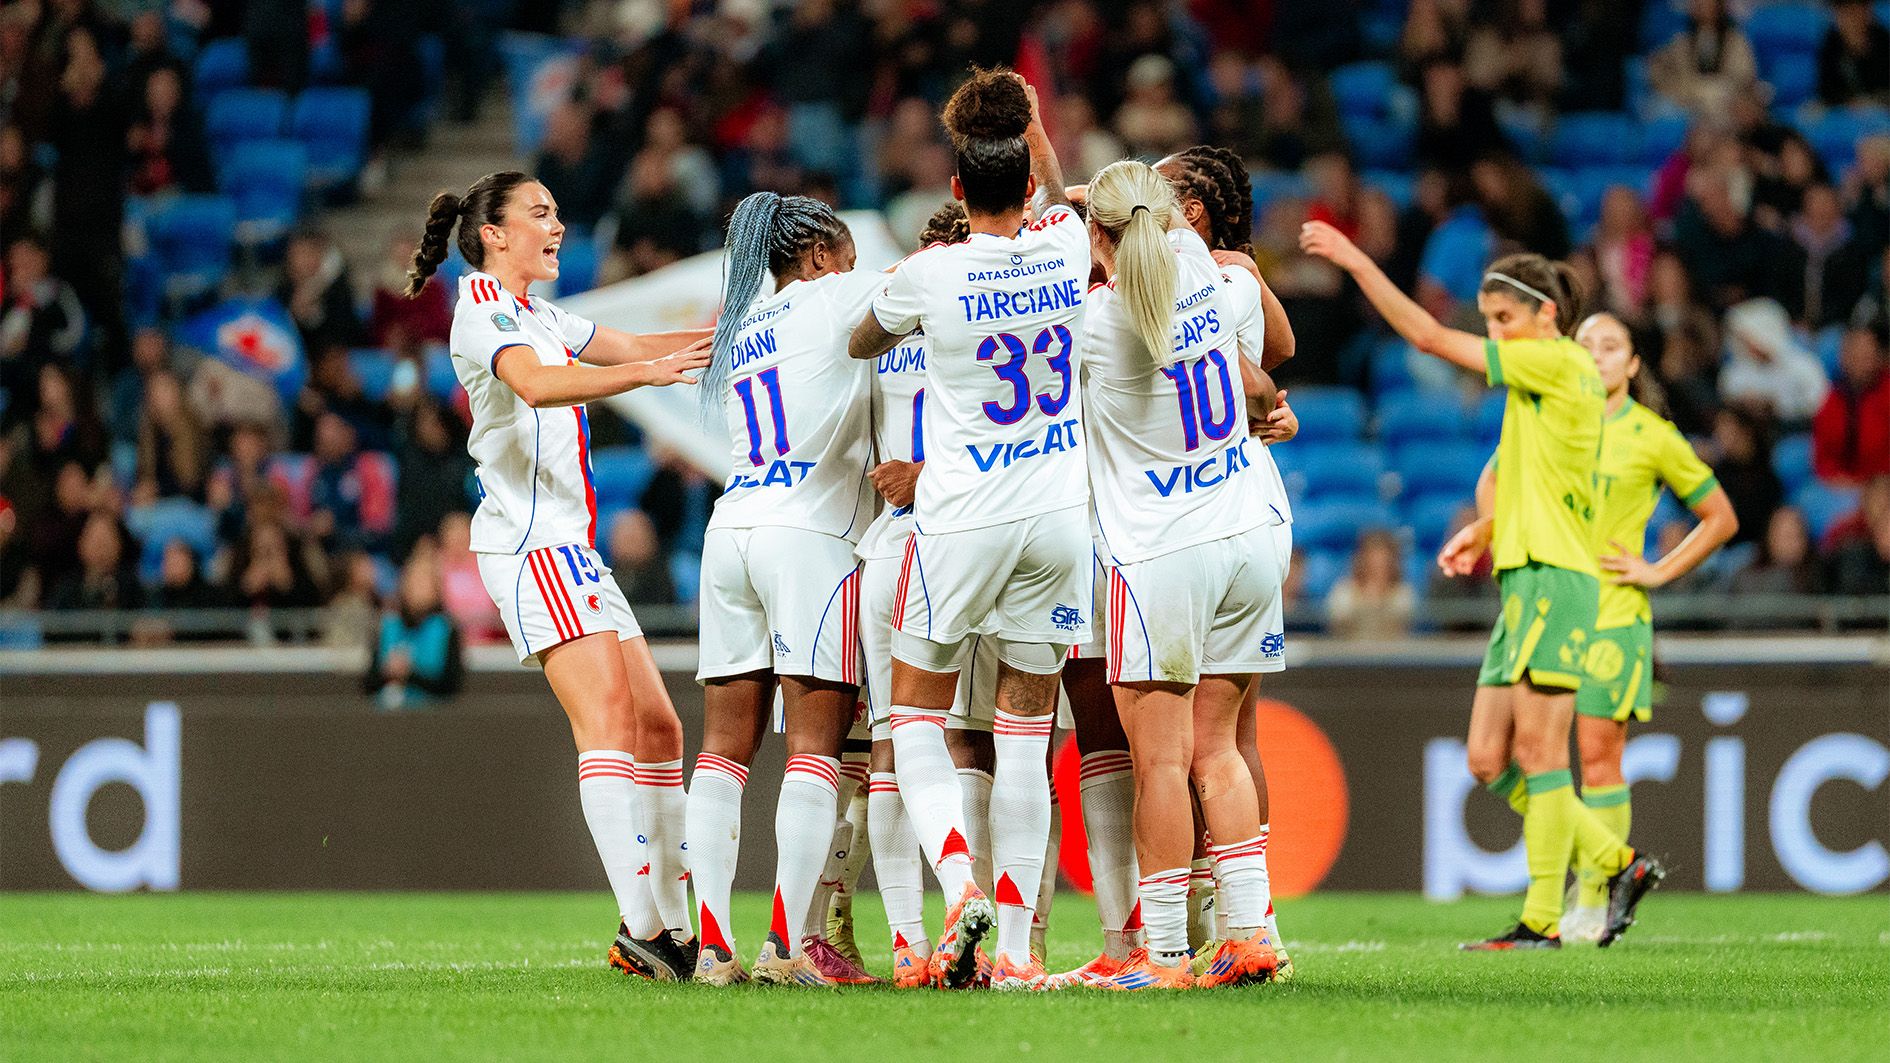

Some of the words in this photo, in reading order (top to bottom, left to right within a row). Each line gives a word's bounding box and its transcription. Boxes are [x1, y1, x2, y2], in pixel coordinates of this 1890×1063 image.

[967, 258, 1065, 281] DATASOLUTION
[958, 278, 1082, 322] TARCIANE
[731, 328, 777, 371] DIANI
[976, 324, 1073, 425] 33
[733, 365, 791, 467] 11
[1160, 347, 1237, 452] 10
[966, 418, 1079, 473] VICAT
[556, 543, 600, 586] 15
